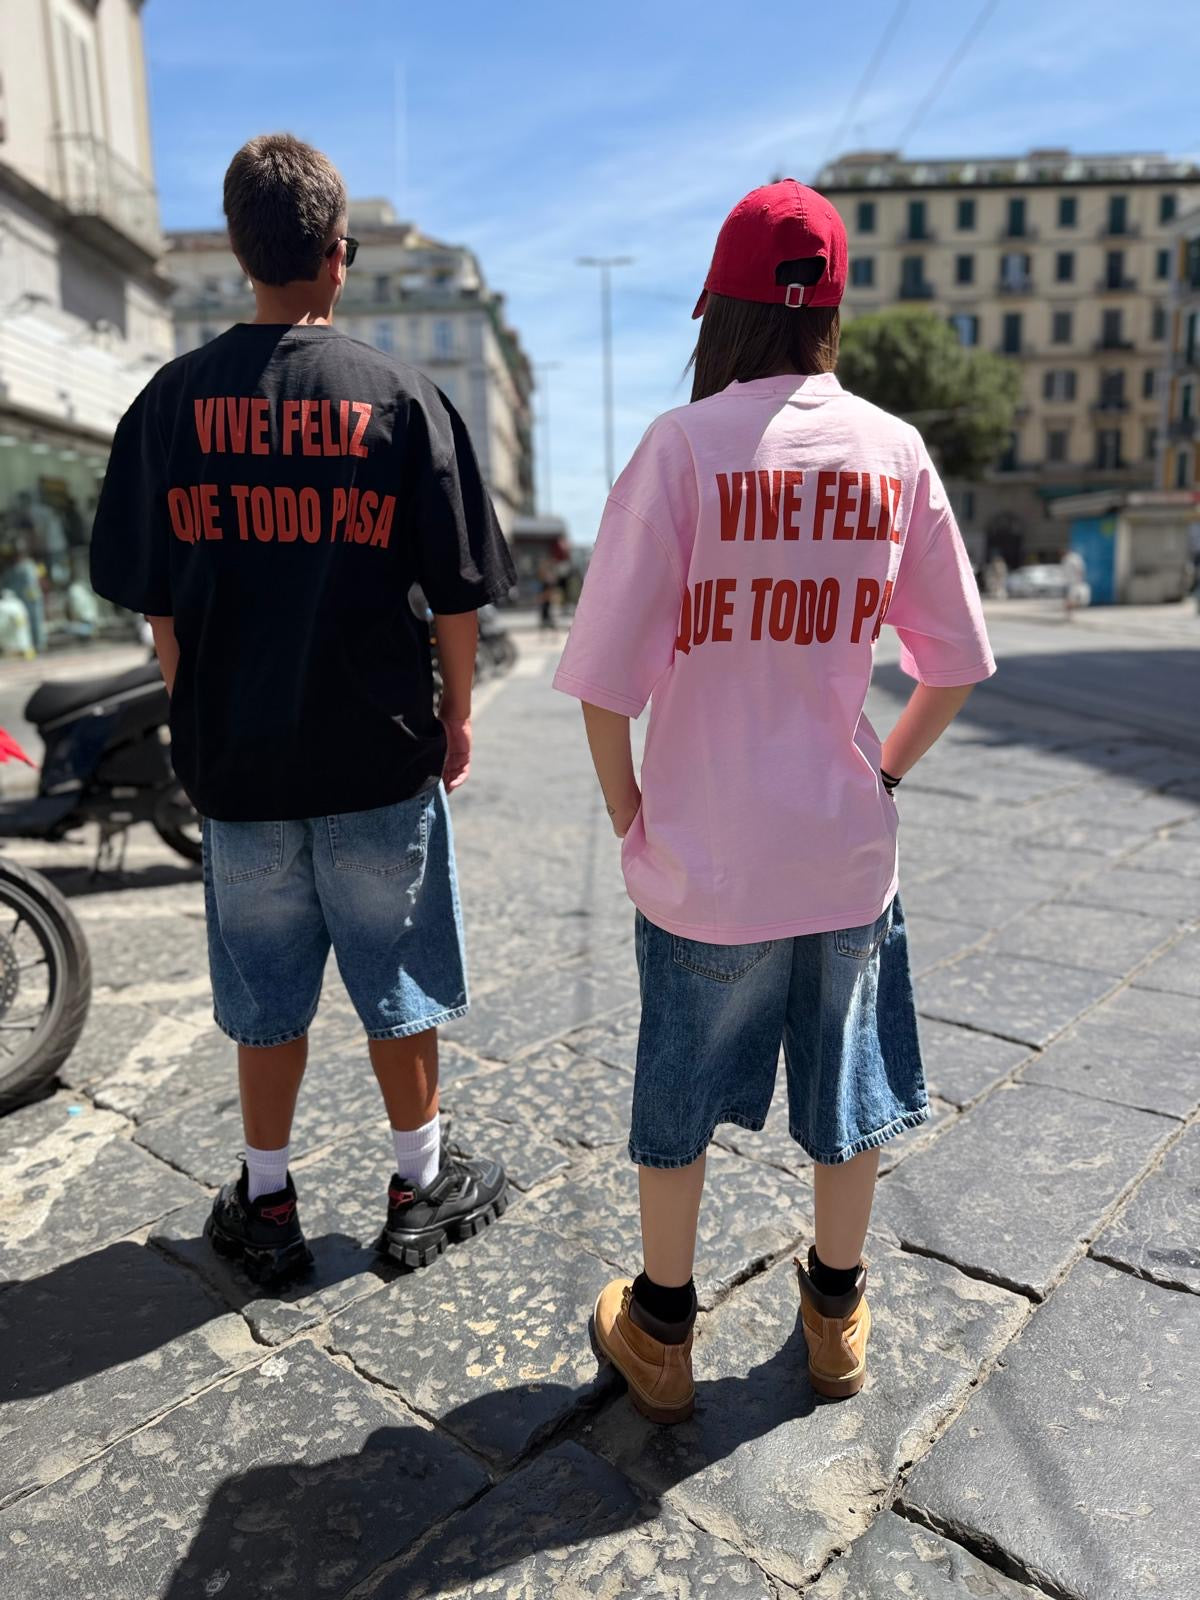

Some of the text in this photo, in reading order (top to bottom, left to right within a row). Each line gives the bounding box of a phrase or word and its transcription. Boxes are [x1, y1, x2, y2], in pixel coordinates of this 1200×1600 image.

[194, 396, 373, 458] VIVE FELIZ
[167, 484, 397, 548] QUE TODO PASA
[716, 470, 902, 544] VIVE FELIZ
[675, 578, 737, 655] QUE
[750, 577, 840, 645] TODO
